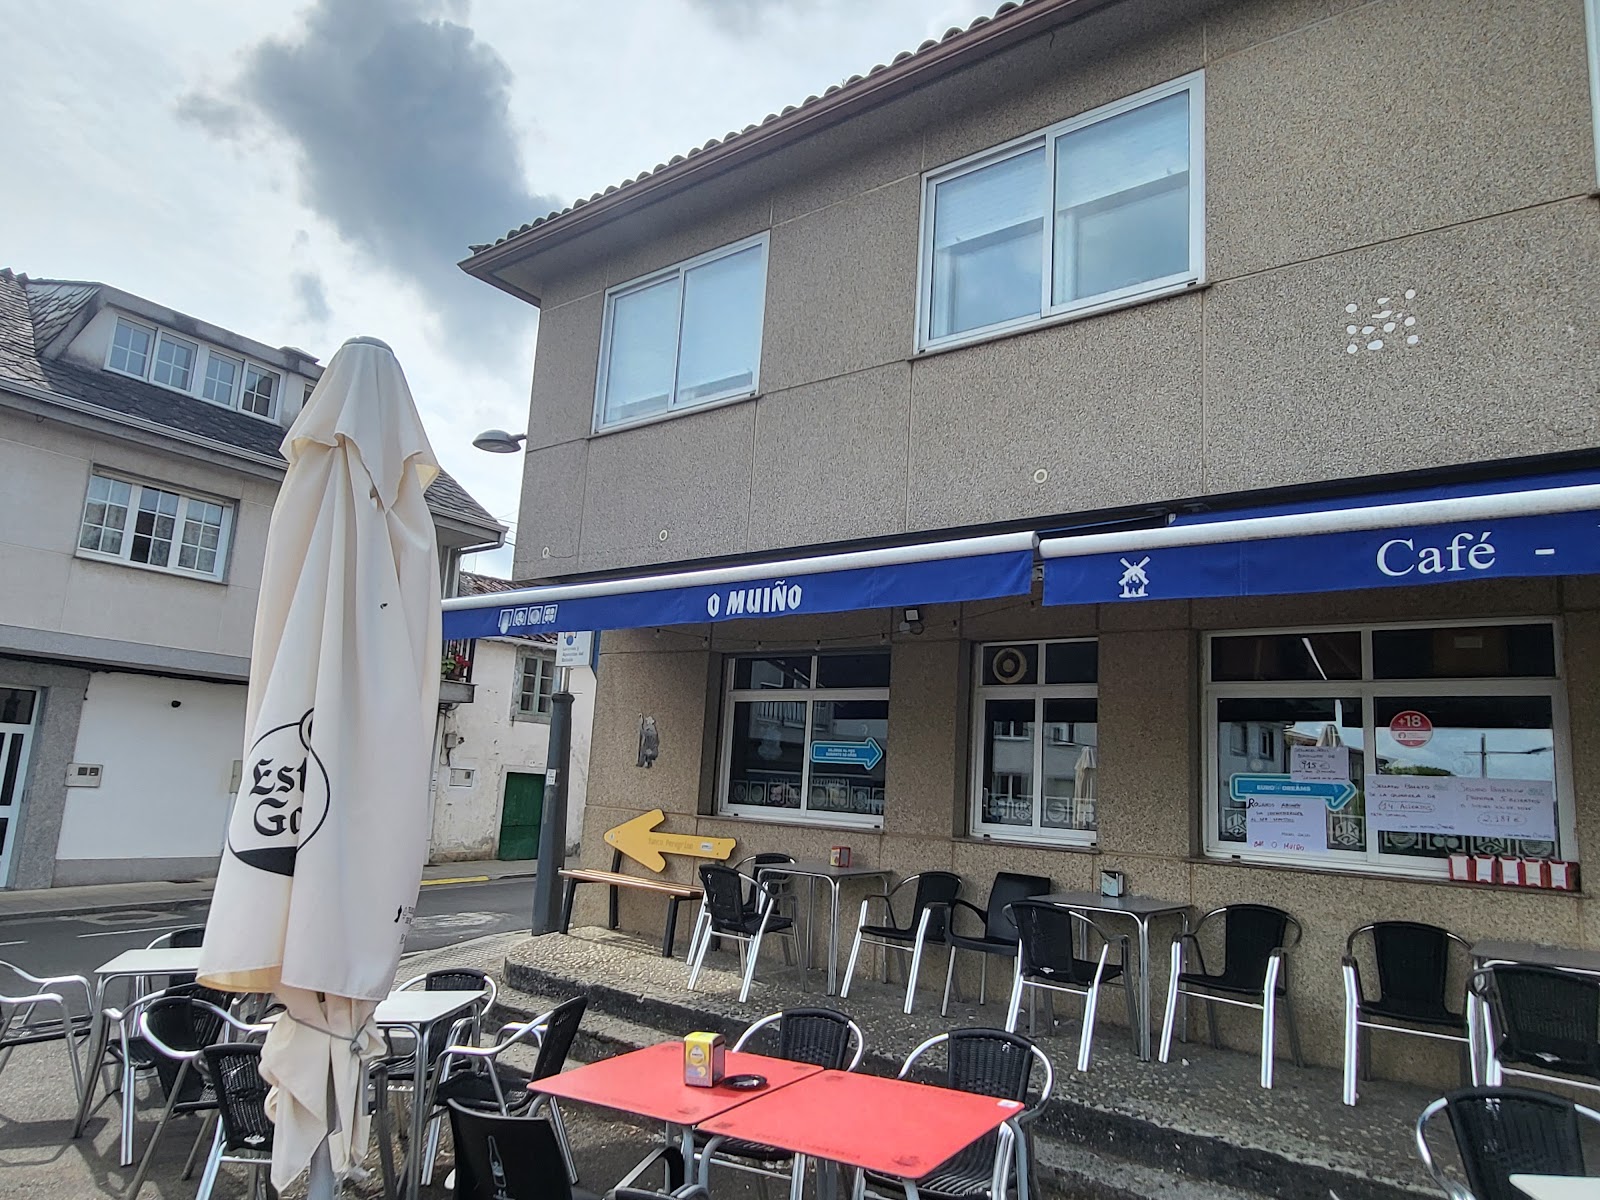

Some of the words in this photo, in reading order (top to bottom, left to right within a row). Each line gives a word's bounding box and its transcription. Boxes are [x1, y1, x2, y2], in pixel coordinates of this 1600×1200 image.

[1376, 531, 1496, 577] Café
[707, 593, 721, 618] O
[726, 580, 802, 615] MUIÑO
[1398, 715, 1422, 727] +18
